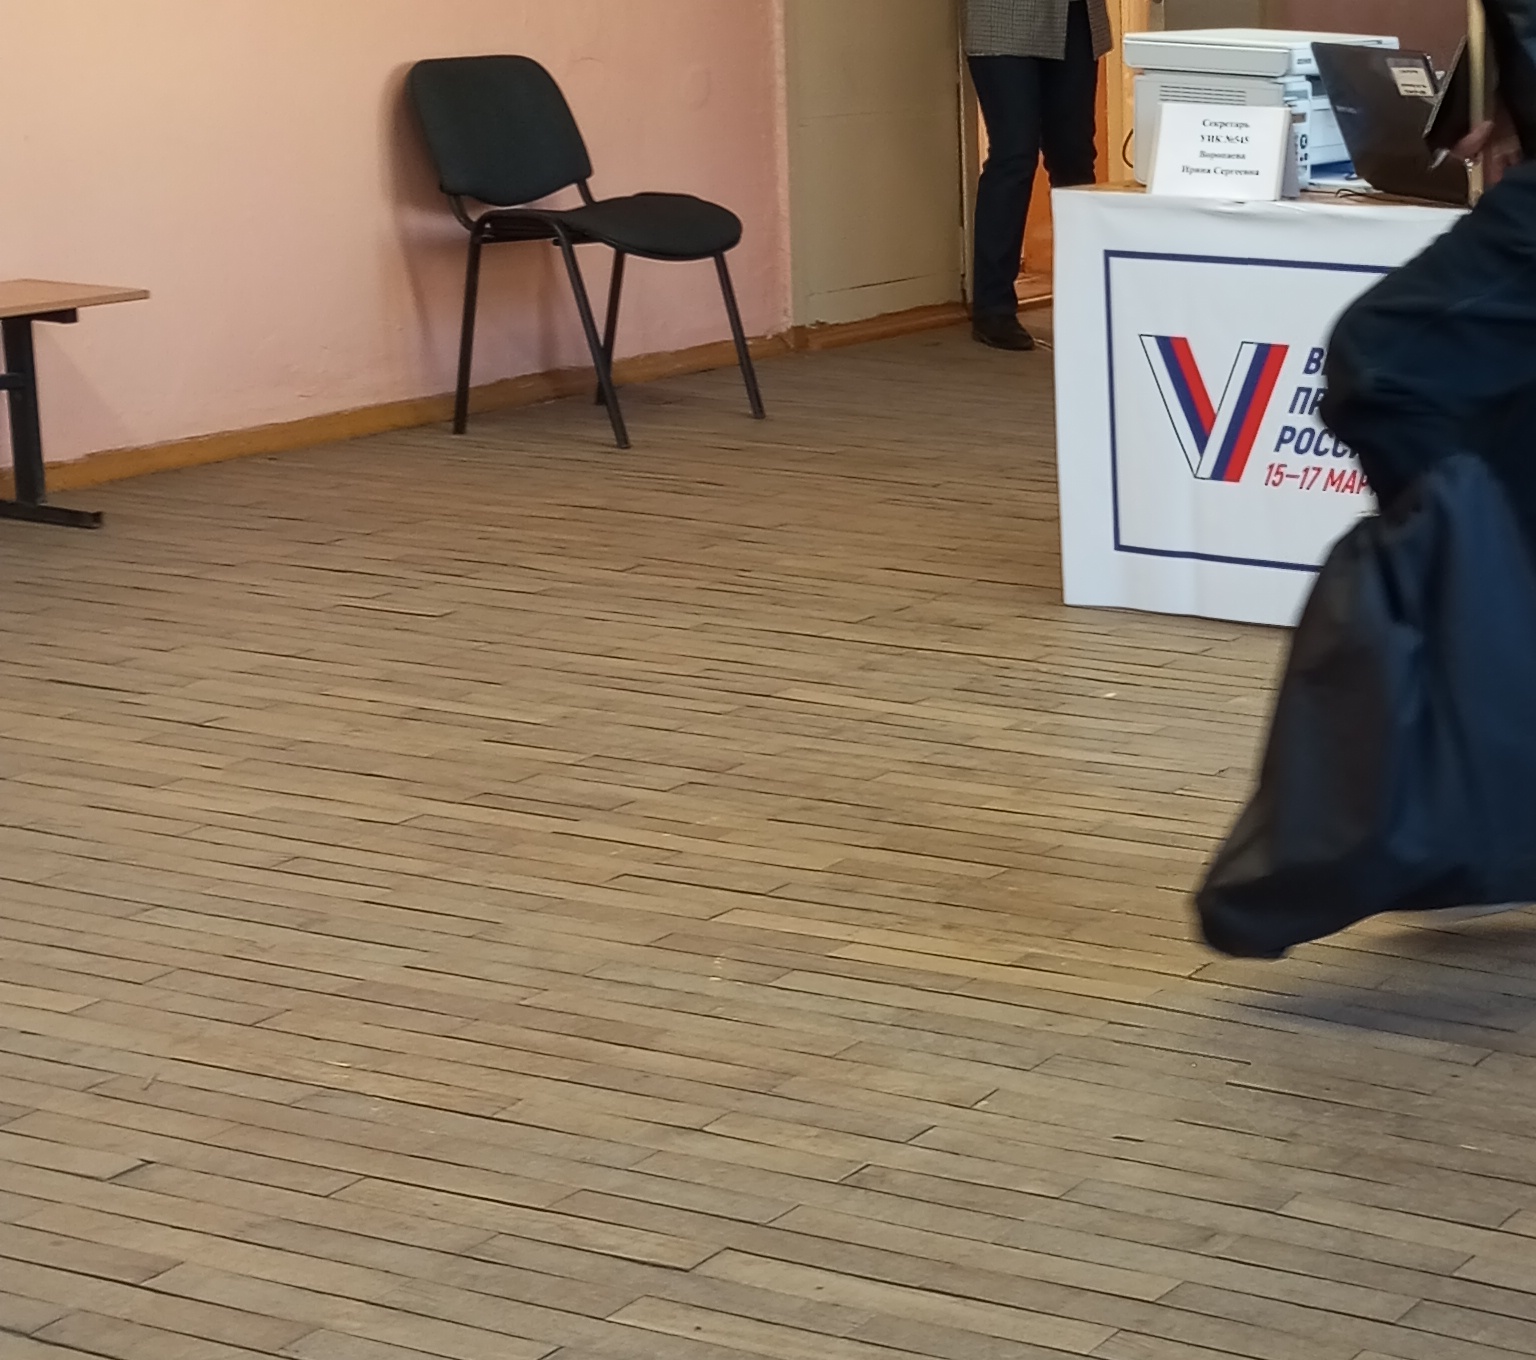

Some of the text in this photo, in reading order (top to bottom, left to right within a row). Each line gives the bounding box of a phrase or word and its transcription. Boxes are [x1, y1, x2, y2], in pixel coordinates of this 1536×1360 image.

[1202, 119, 1251, 130] Секретарь
[1181, 165, 1260, 177] Ирина Сергеевна
[1273, 425, 1359, 459] РОСС
[1322, 468, 1376, 496] МАР
